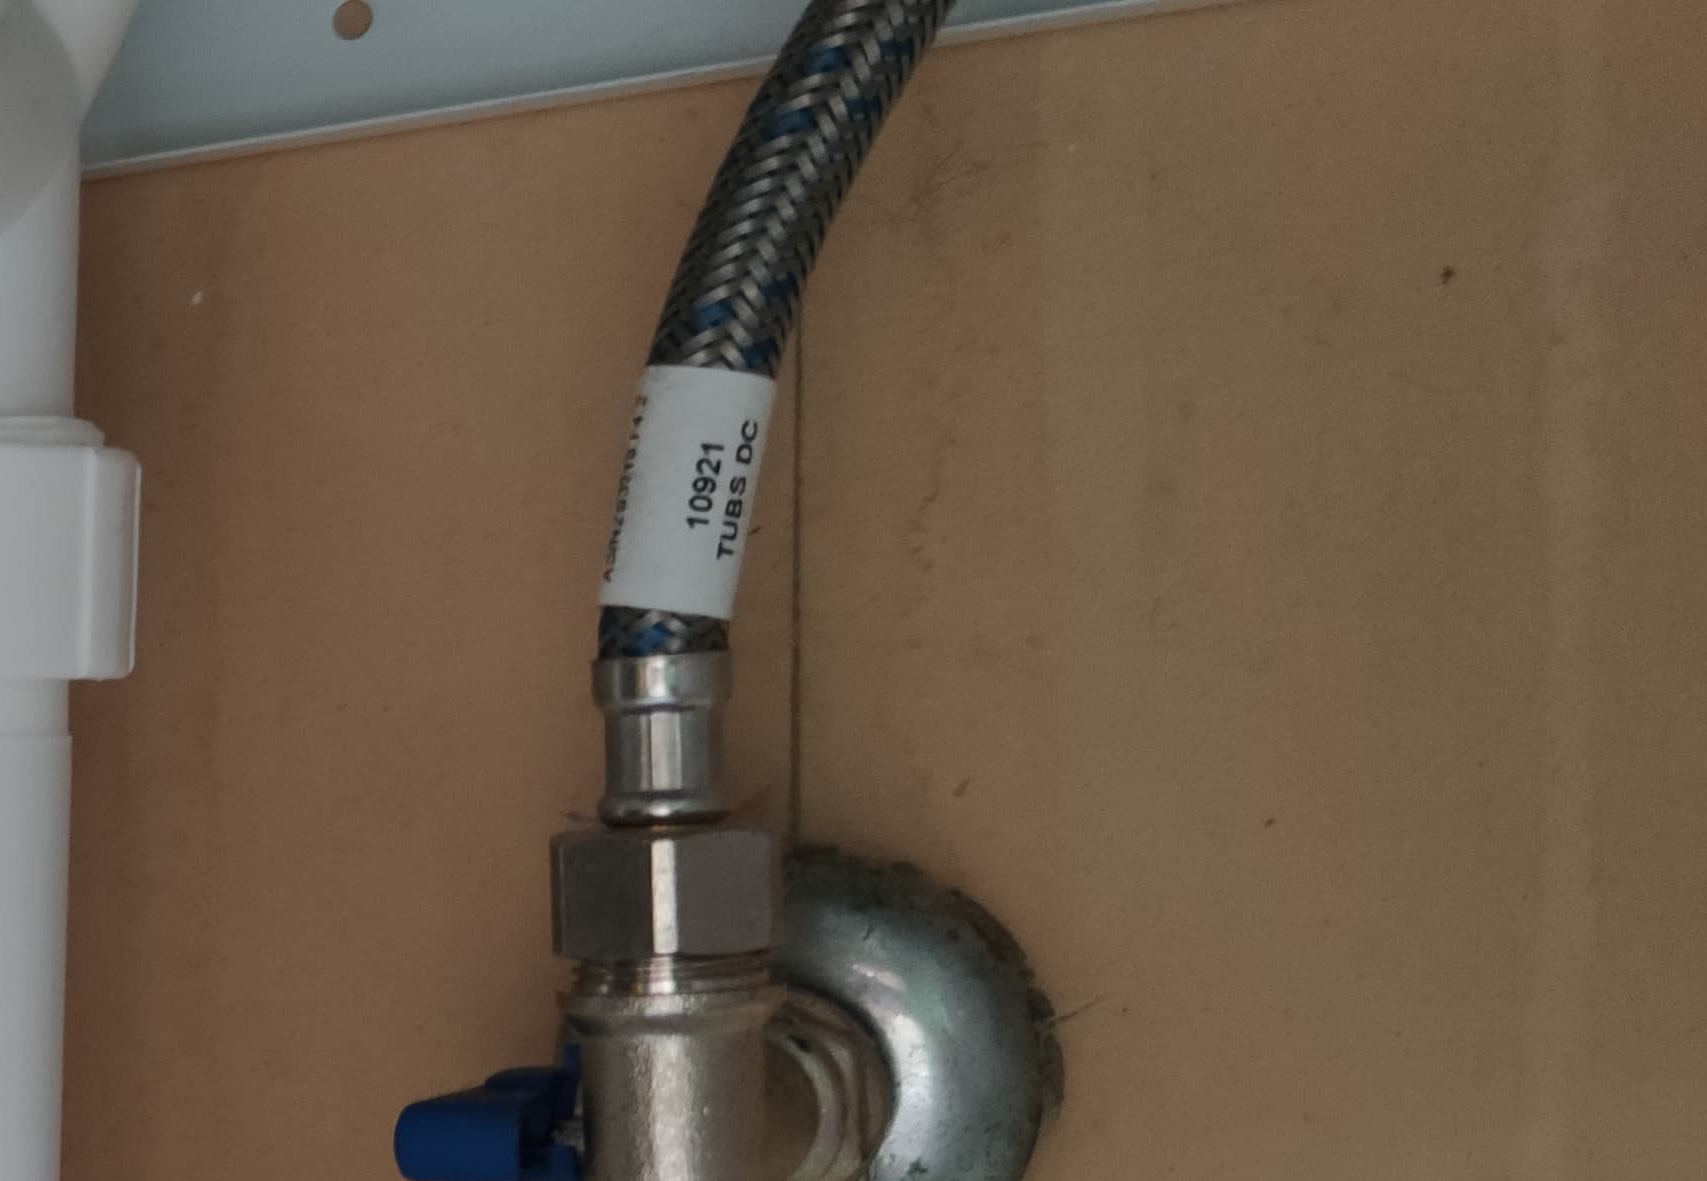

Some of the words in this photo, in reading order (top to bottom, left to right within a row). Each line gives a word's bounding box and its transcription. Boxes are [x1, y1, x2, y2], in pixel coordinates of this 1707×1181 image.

[686, 441, 725, 530] 10921
[716, 475, 748, 560] TUBS
[735, 419, 759, 465] DC
